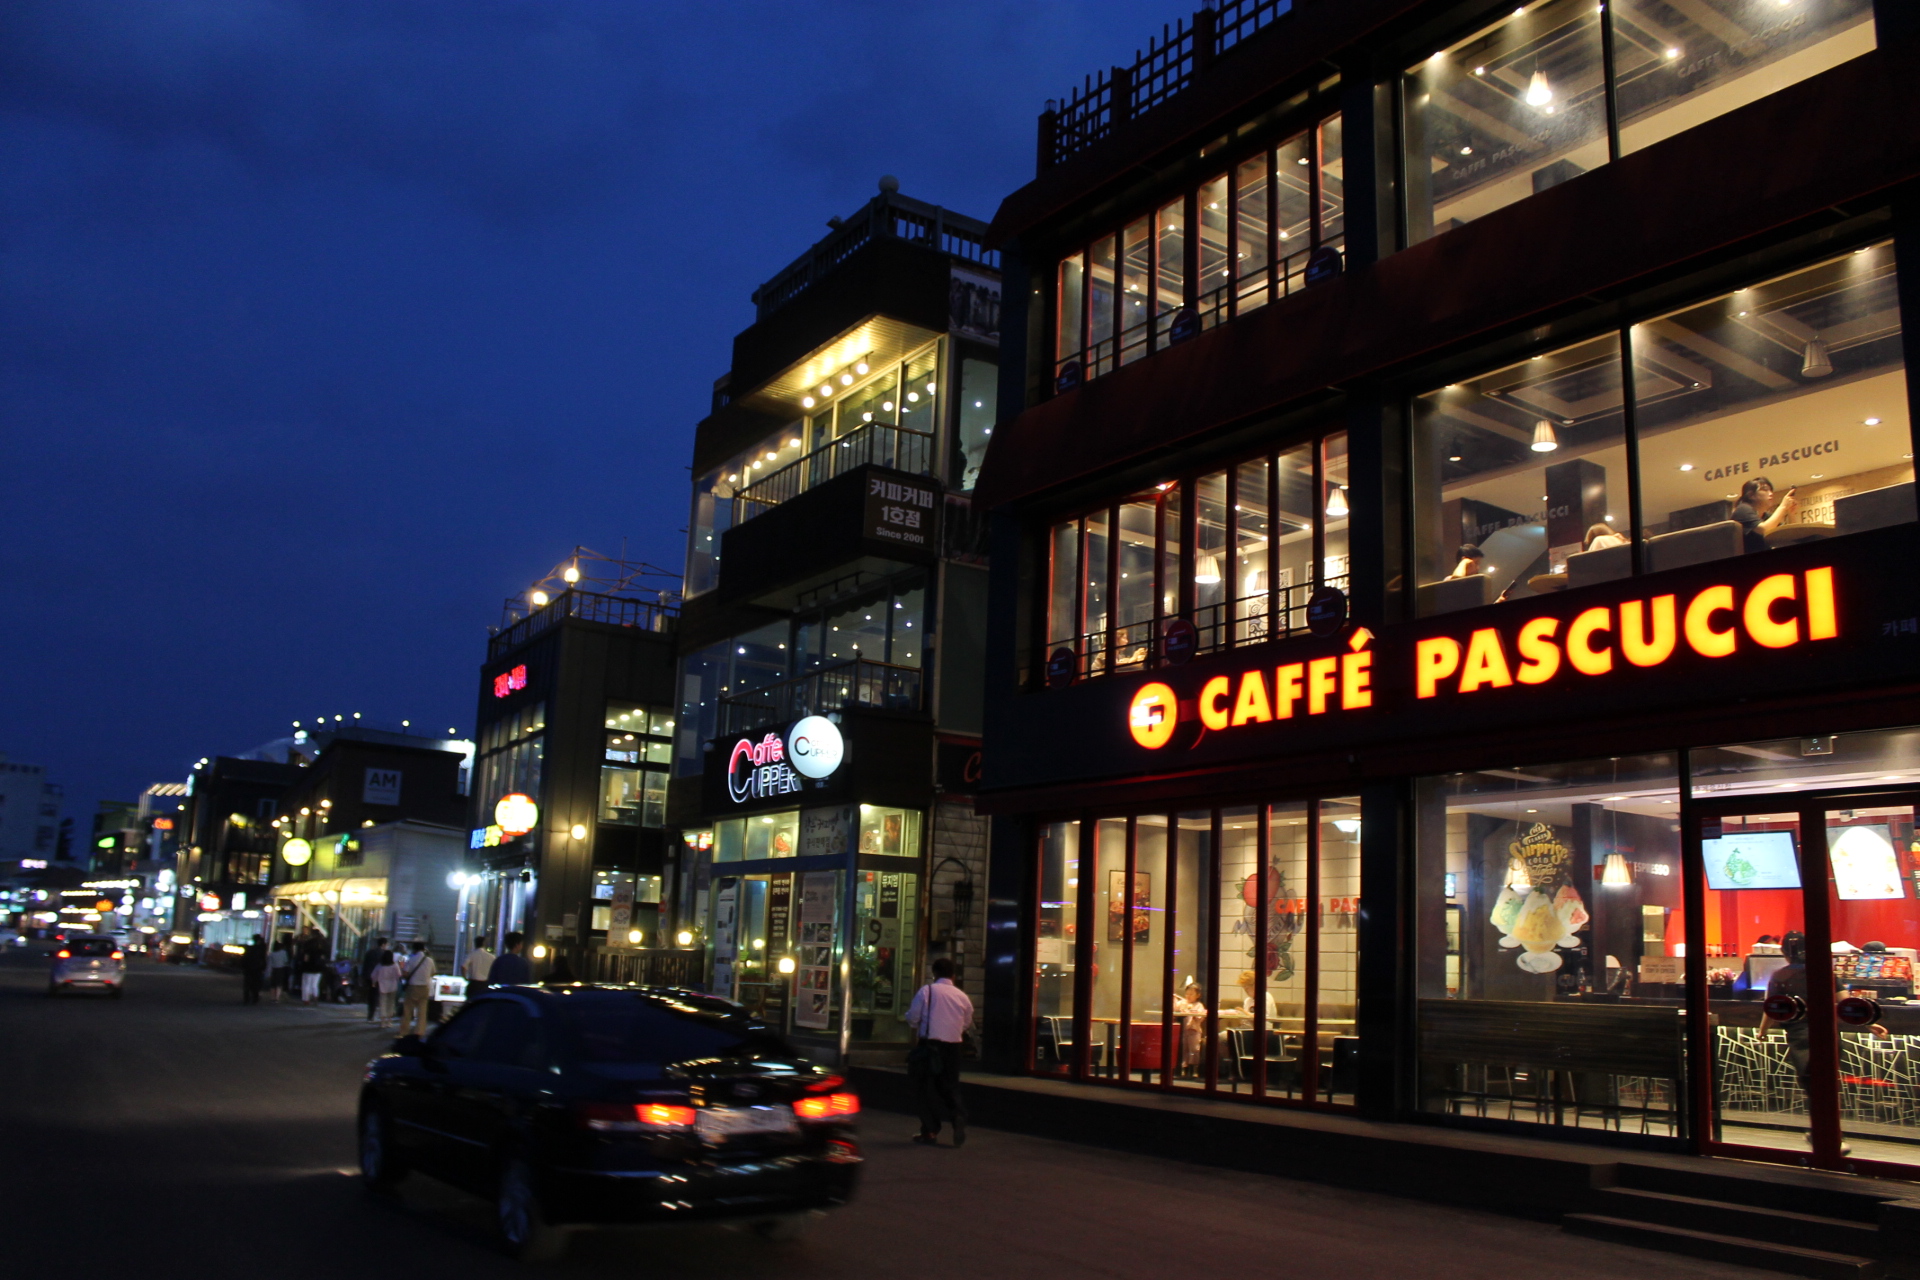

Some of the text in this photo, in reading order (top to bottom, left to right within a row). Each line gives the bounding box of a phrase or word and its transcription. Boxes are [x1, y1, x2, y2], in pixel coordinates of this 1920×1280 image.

[1703, 439, 1840, 482] CAFFE PASCUCCI
[870, 479, 933, 509] 커피커퍼
[882, 505, 920, 528] 1호점
[876, 527, 924, 544] Since 2001
[1881, 617, 1919, 637] 카페
[1199, 565, 1838, 731] CAFFÉ PASCUCCI
[368, 772, 397, 789] AM
